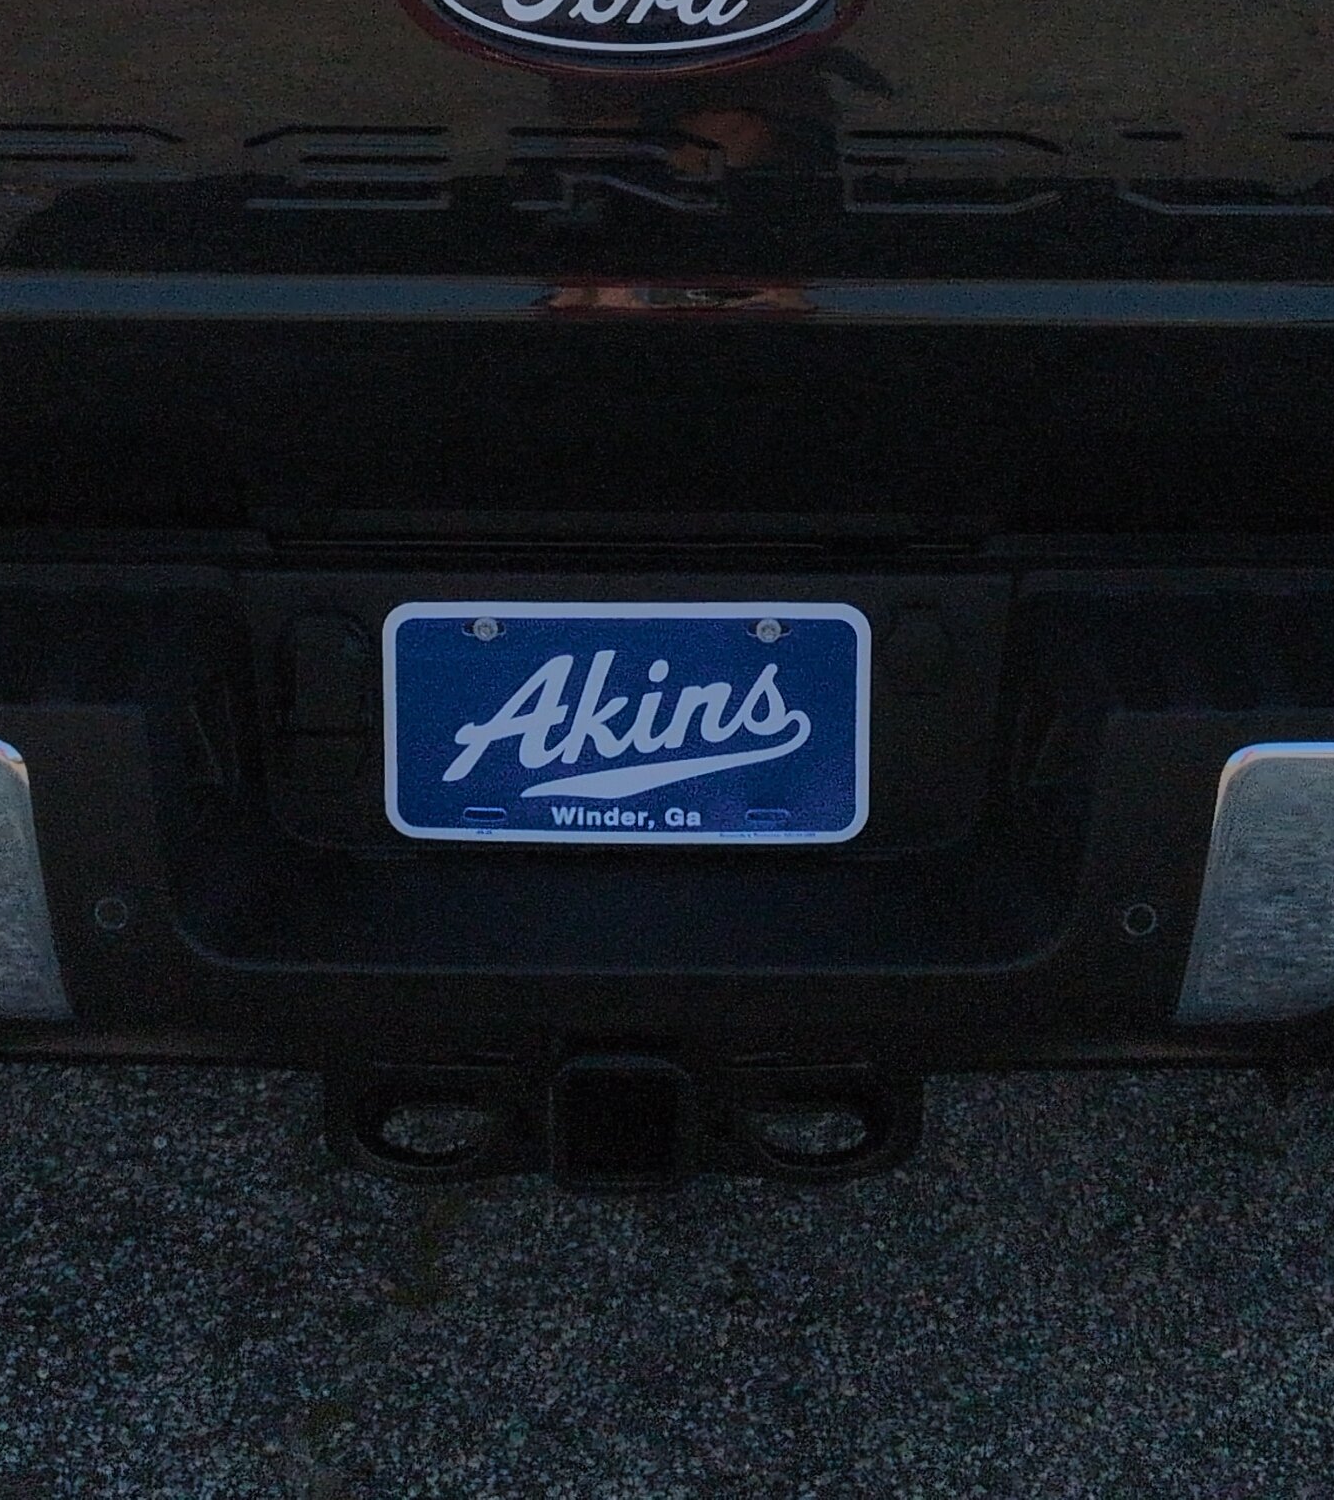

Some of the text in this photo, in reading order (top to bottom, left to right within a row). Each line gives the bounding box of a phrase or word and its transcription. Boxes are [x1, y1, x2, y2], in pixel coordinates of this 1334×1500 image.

[442, 650, 812, 800] Akins
[551, 806, 702, 830] Winder, Ga
